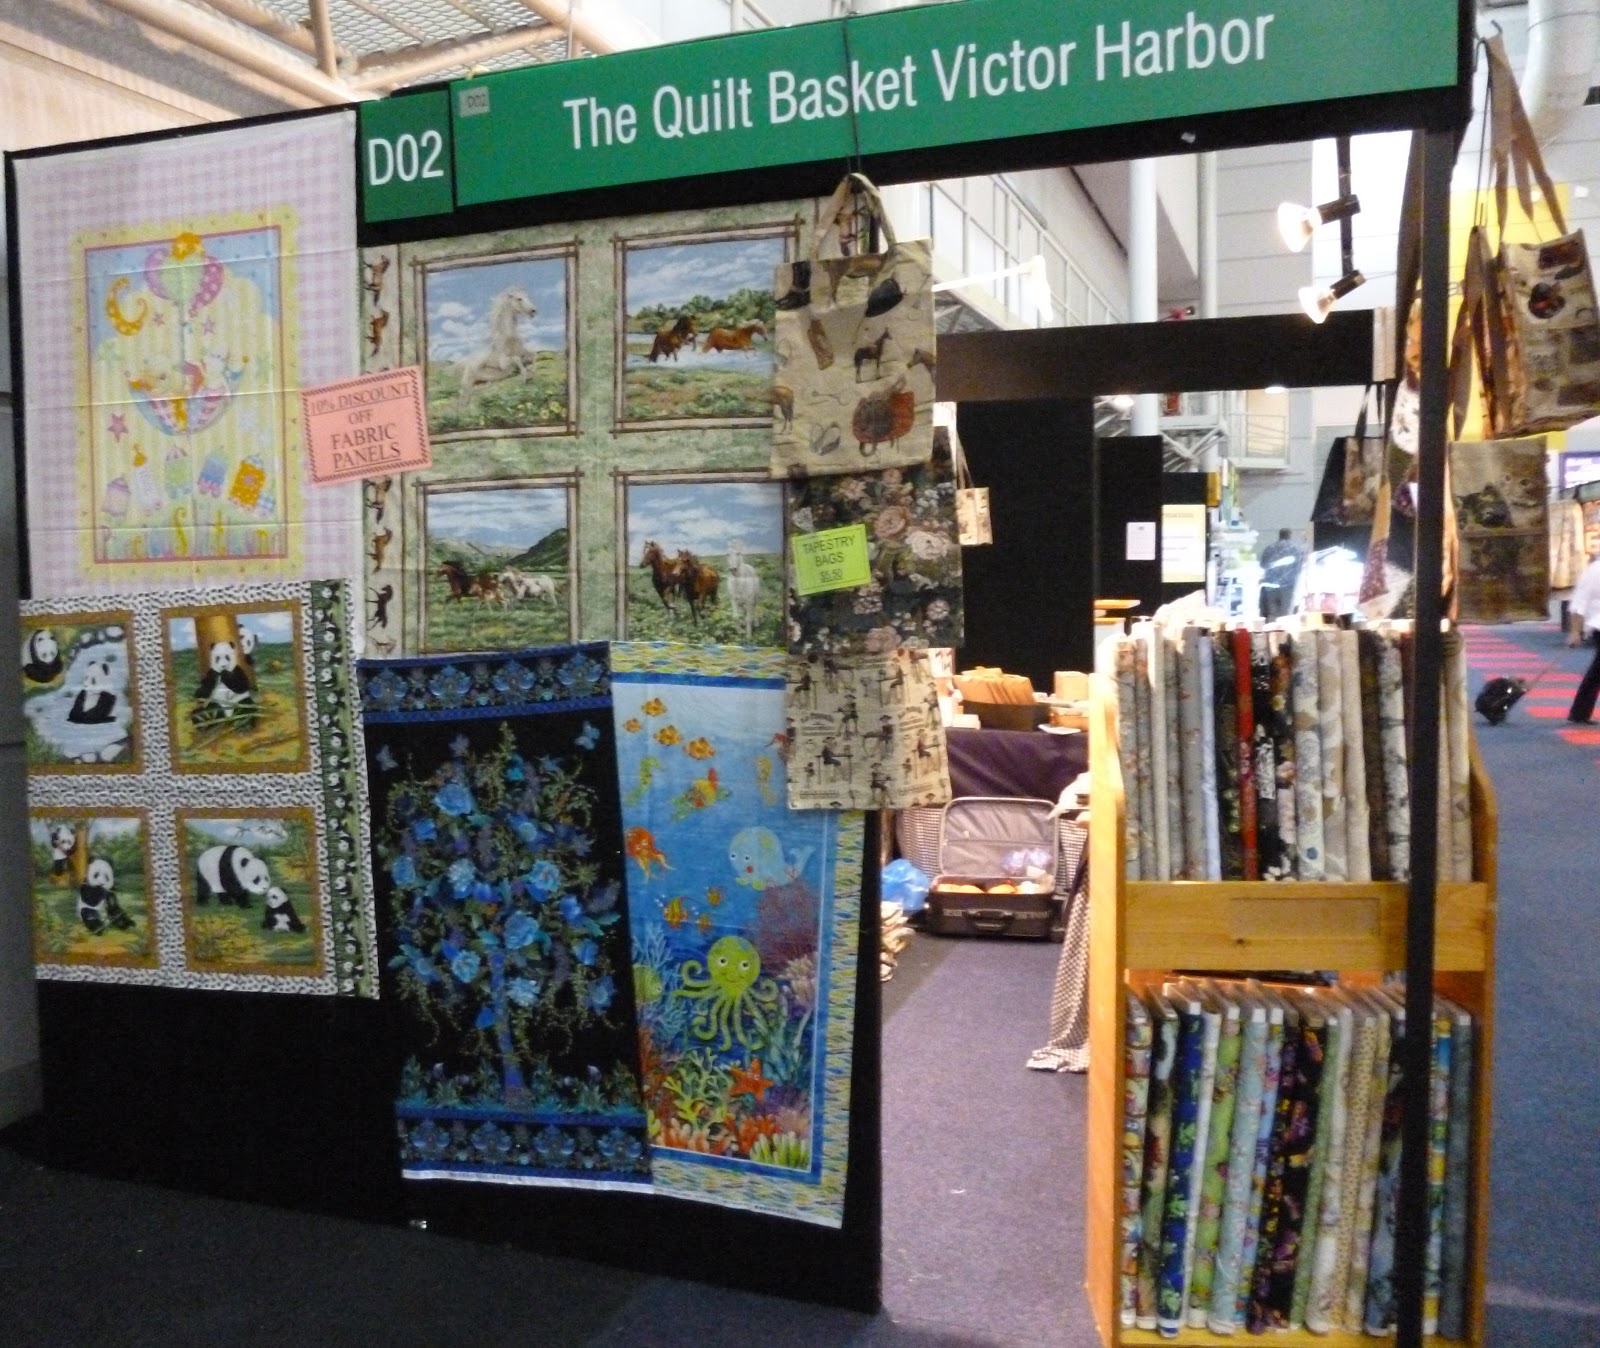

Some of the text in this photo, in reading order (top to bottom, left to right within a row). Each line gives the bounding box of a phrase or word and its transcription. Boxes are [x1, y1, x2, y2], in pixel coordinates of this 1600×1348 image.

[563, 12, 1275, 150] The Quilt Basket Victor Harbor
[368, 130, 445, 186] D02
[310, 382, 410, 414] 10% DISCOUNT
[348, 409, 374, 425] OFF
[331, 423, 397, 450] FABRIC
[333, 442, 402, 469] PANELS
[803, 535, 856, 554] TAPESTRY
[815, 552, 845, 567] BAGS
